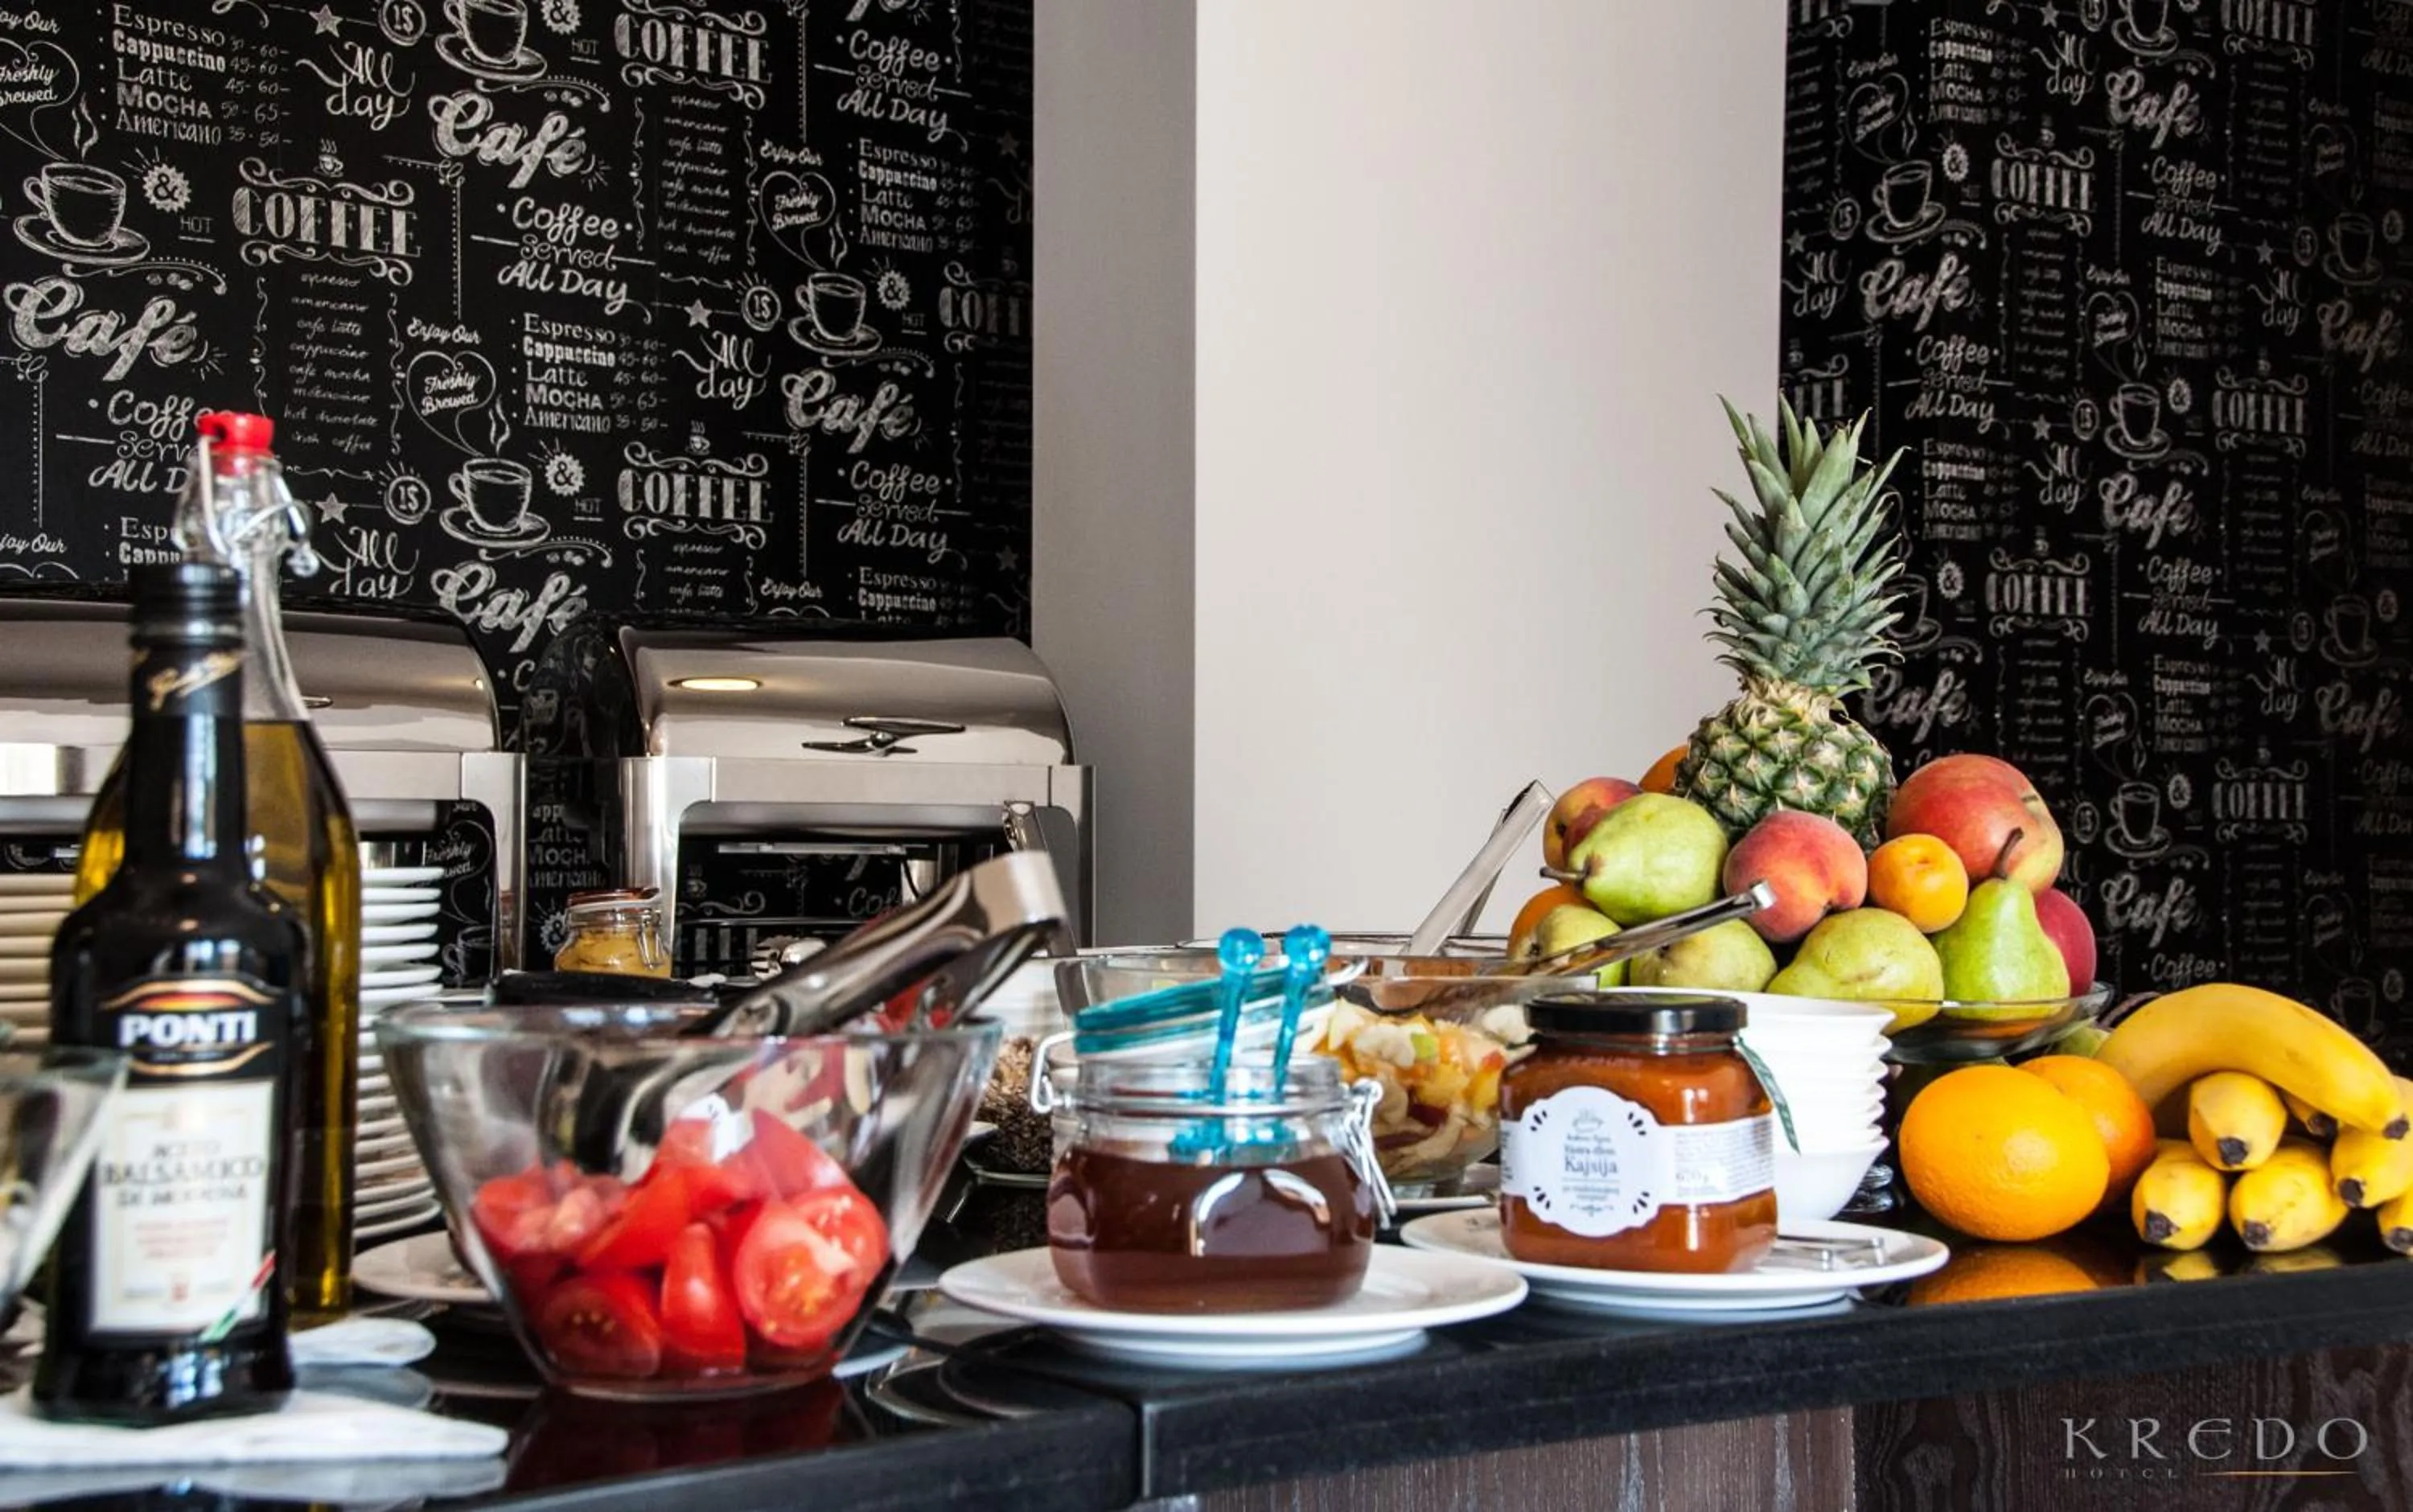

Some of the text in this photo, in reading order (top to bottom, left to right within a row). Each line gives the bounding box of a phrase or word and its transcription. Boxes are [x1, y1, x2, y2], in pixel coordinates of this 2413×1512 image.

[23, 10, 61, 35] Our
[112, 3, 226, 47] Espresso
[112, 29, 226, 73] Cappuccino
[571, 39, 601, 56] HOT
[615, 12, 771, 83] COFFEE
[849, 30, 940, 76] Coffee
[117, 57, 193, 92] Latte
[330, 42, 415, 98] All
[856, 64, 938, 101] Served
[1930, 62, 1974, 82] Latte
[2046, 66, 2089, 105] day
[117, 83, 213, 118] MOCHA
[323, 74, 410, 131] day
[837, 90, 948, 143] All Day
[2104, 66, 2201, 150] Café
[116, 107, 222, 146] Americano
[428, 90, 586, 188] Café
[760, 139, 823, 166] Enjoy Our
[859, 137, 937, 170] Espresso
[857, 158, 937, 191] Cappuccino
[2151, 155, 2218, 195] Coffee
[861, 182, 914, 209] Latte
[179, 216, 214, 234] HOT
[232, 187, 421, 257] COFFEE
[513, 196, 619, 244] Coffee
[860, 203, 927, 232] MOCHA
[2140, 213, 2222, 257] All Day
[520, 234, 617, 271] Served
[859, 224, 934, 254] Americano
[290, 296, 369, 312] americano
[498, 260, 627, 315] All Day
[1792, 282, 1845, 320] day
[1859, 251, 1972, 334] Café
[3, 276, 199, 382] Café
[406, 317, 483, 345] Enjoy Our
[524, 312, 615, 344] Espresso
[2316, 298, 2403, 373] Café
[289, 343, 371, 360] cappuccino
[523, 335, 615, 368] Cappuccino
[711, 331, 771, 379] All
[1916, 335, 1991, 372] Coffee
[424, 372, 481, 396] Freshly
[527, 360, 588, 387] Latte
[695, 360, 764, 411] day
[421, 391, 479, 416] Brewed
[525, 382, 603, 411] MOCHA
[781, 368, 914, 453] Café
[1905, 390, 1996, 434] All Day
[524, 405, 611, 433] Americano
[88, 458, 158, 492] All
[850, 460, 940, 502] Coffee
[573, 499, 602, 513] HOT
[617, 468, 774, 524] COFFEE
[856, 493, 938, 523] Served
[2037, 479, 2086, 516] day
[2099, 472, 2197, 550] Café
[31, 533, 67, 554] Our
[347, 528, 419, 574] All
[837, 518, 948, 565] All Day
[760, 577, 796, 600] Enjoy
[858, 565, 938, 590] Espresso
[2146, 555, 2212, 592] Coffee
[430, 561, 588, 653] Café
[857, 587, 938, 612] Cappuccino
[2137, 610, 2218, 651] All Day
[2099, 872, 2200, 950] Café
[2149, 953, 2218, 986] Coffee
[120, 1011, 257, 1046] PONTI
[1564, 1156, 1618, 1179] Kajsija
